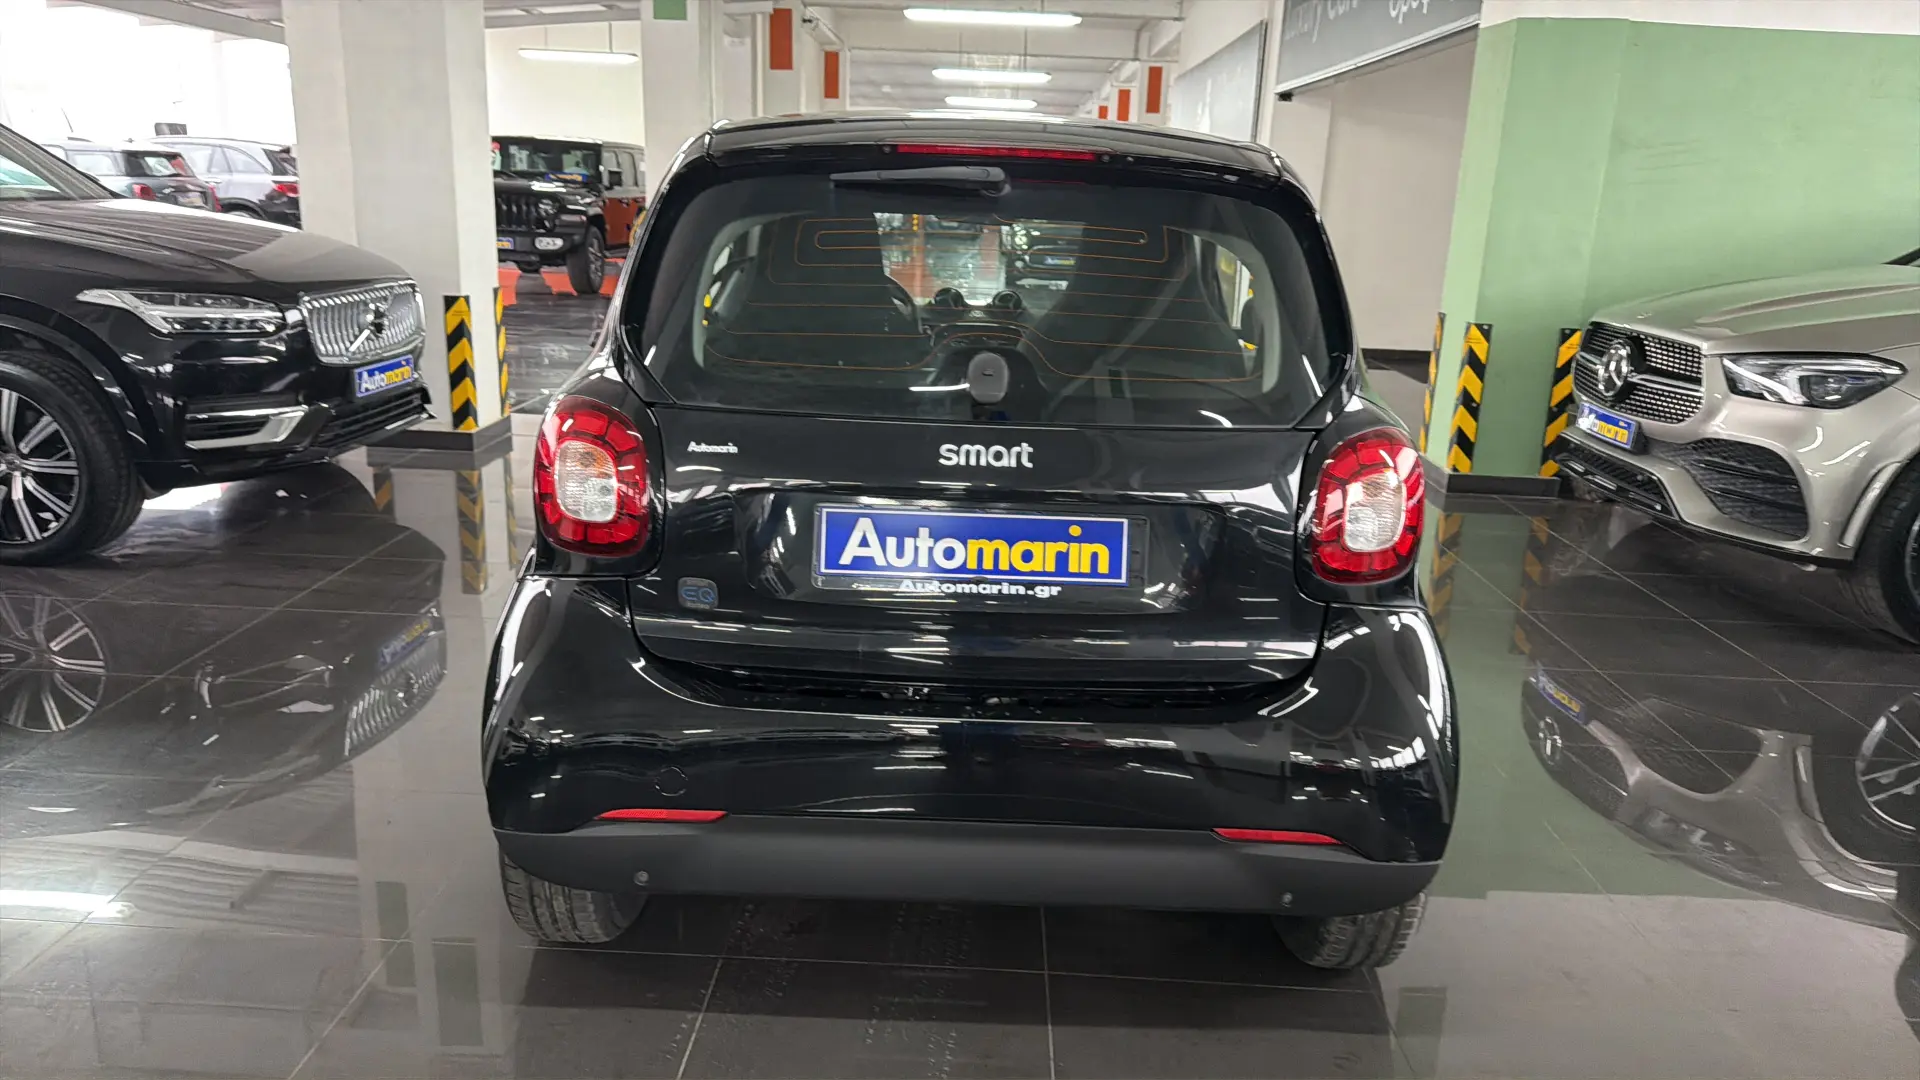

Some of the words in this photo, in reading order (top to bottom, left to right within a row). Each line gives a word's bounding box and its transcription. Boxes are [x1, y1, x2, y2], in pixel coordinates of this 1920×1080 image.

[938, 442, 1034, 469] smart
[838, 516, 1111, 575] Automarin
[681, 586, 715, 603] EQ
[899, 579, 1062, 598] Automarin.gr
